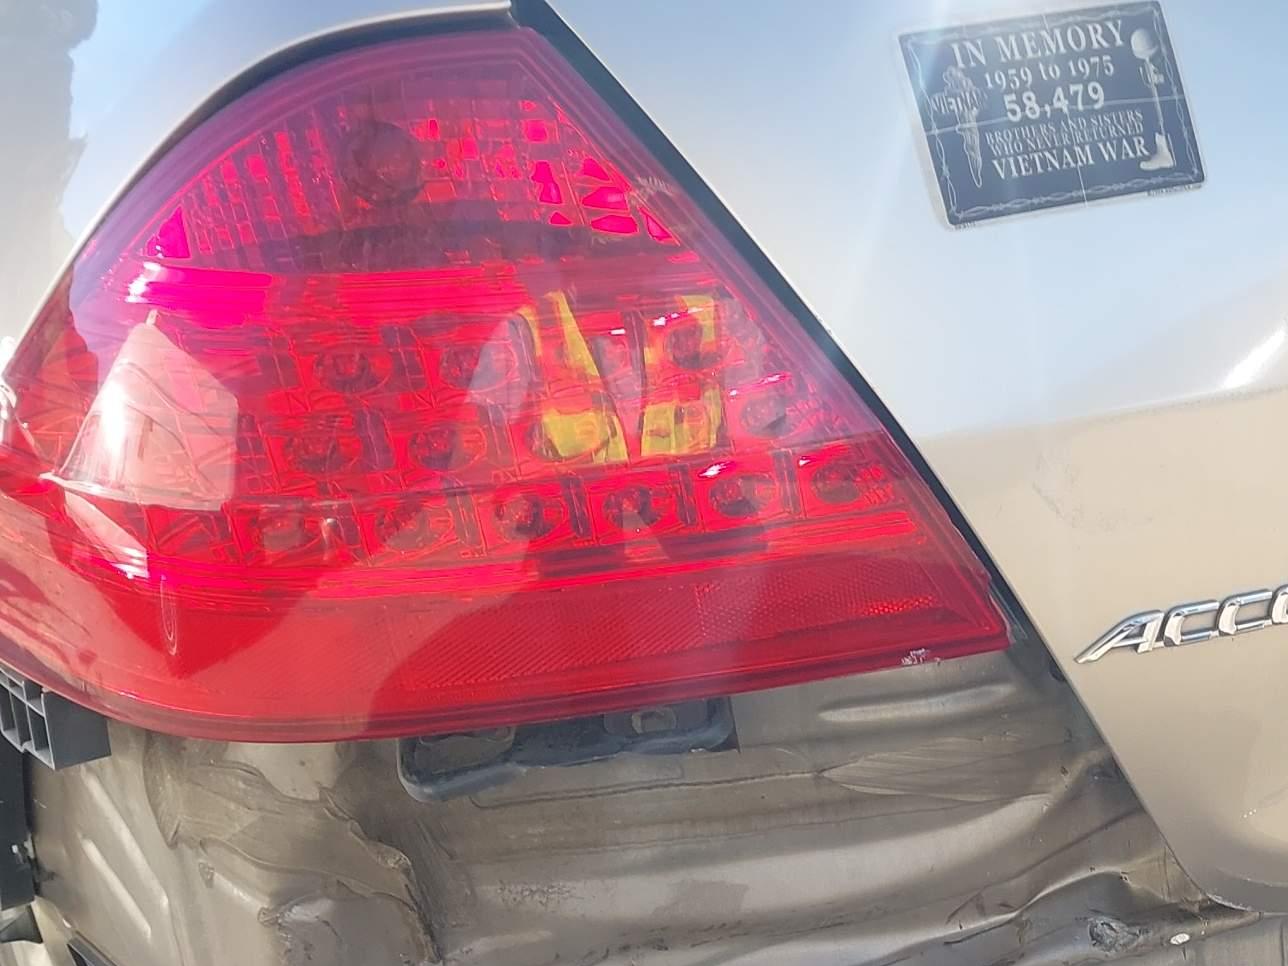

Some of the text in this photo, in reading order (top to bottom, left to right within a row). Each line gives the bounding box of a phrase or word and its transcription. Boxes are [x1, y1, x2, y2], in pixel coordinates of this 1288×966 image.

[951, 20, 1125, 69] IN MEMORY
[985, 55, 1115, 91] 1959 to 1975
[1003, 81, 1106, 122] 58,479
[985, 124, 1055, 145] BROTHERS
[1091, 109, 1144, 127] SISTERS
[988, 121, 1145, 158] WHO NEVER RETURNED
[992, 136, 1150, 180] VIETNAM WAR
